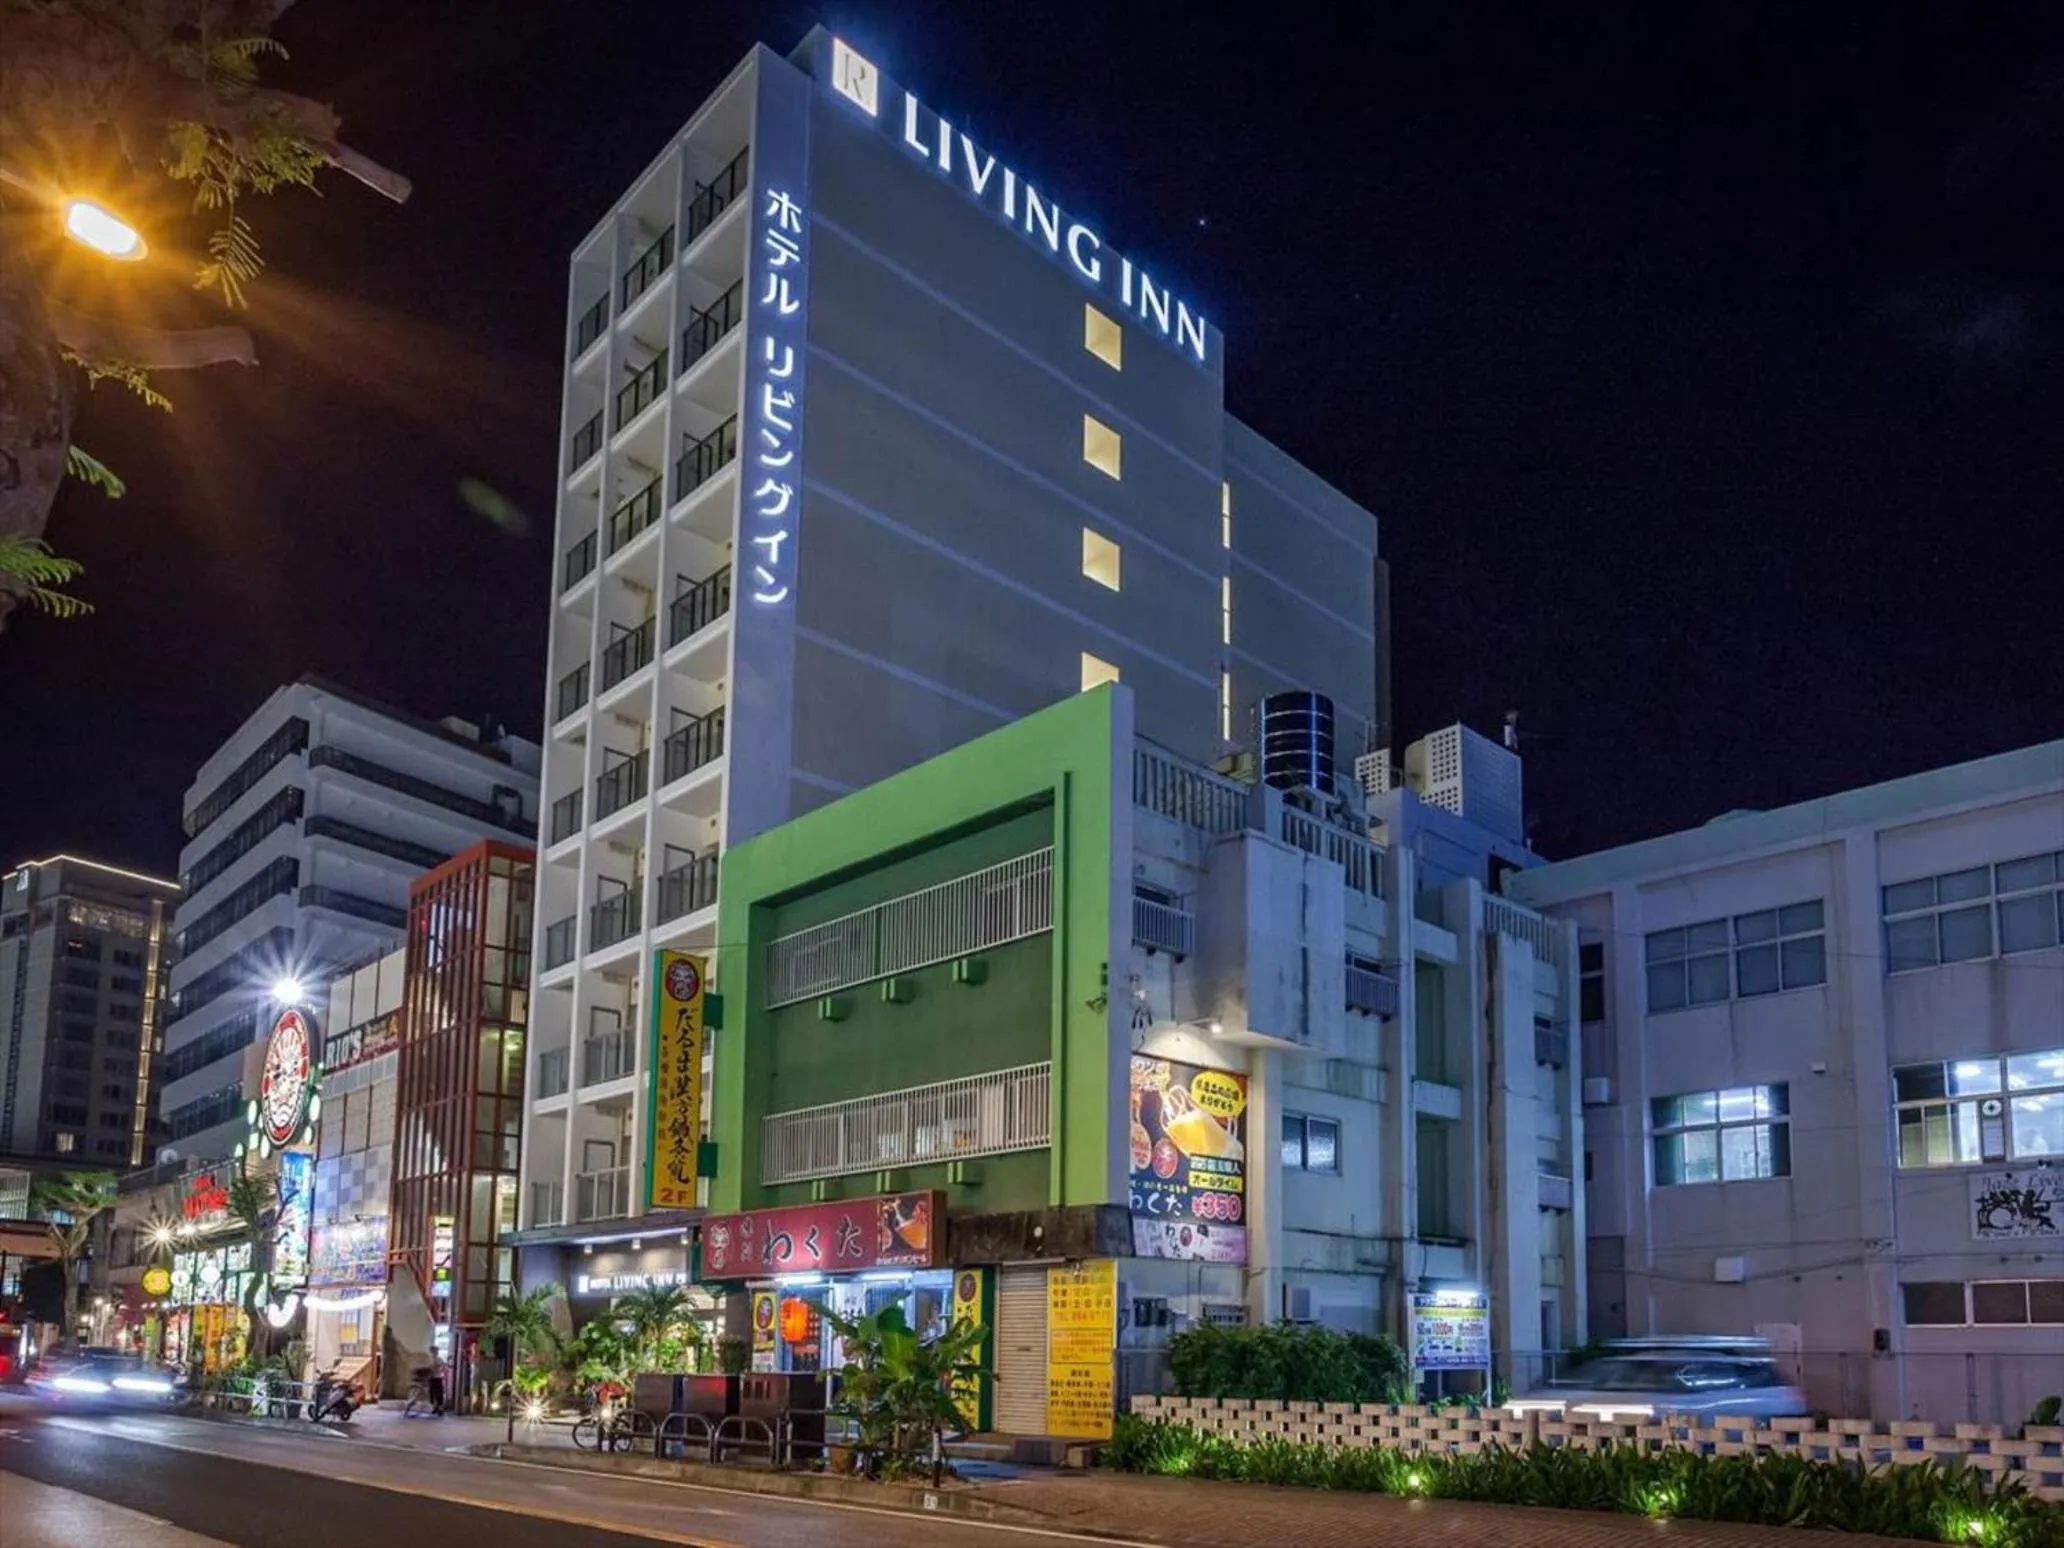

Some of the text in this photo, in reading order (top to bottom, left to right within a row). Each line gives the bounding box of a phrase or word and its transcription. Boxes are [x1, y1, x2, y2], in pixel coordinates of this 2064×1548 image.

[905, 91, 1205, 360] LIVING INN
[753, 188, 803, 605] ホテル リビングイン
[660, 1187, 689, 1204] 2F
[762, 1214, 864, 1265] わくた
